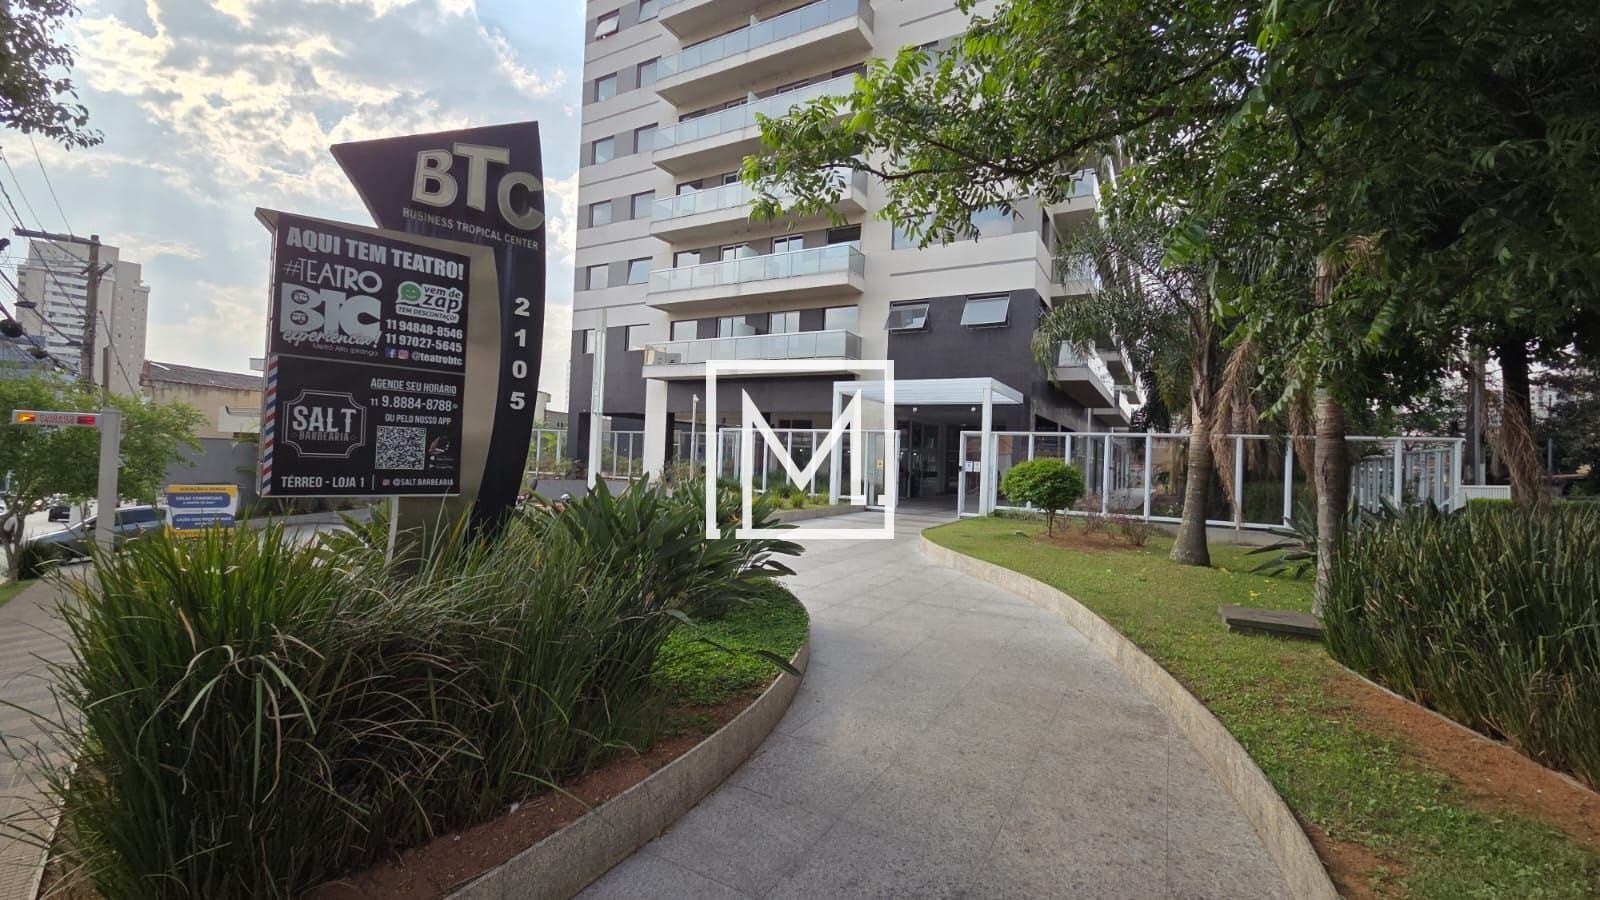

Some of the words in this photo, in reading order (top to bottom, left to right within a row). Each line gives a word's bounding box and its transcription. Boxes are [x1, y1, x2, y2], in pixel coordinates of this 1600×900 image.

[411, 142, 545, 231] BTC
[402, 207, 454, 229] BUSINESS
[456, 221, 502, 241] TROPICAL
[504, 234, 539, 250] CENTER
[286, 226, 340, 255] AQUI
[345, 238, 386, 265] TEM
[392, 249, 464, 281] TEATRO!
[283, 257, 383, 294] #TEATRO
[424, 286, 446, 297] vem
[448, 290, 461, 299] de
[280, 282, 382, 338] BTC
[422, 294, 460, 313] zap
[386, 319, 397, 330] 11
[385, 333, 397, 344] 11
[399, 335, 462, 352] 97027-5645
[411, 350, 463, 366] @teatrobtc
[510, 297, 530, 410] 2105
[370, 378, 405, 390] AGENDE
[406, 381, 422, 392] SEU
[371, 398, 379, 407] 11
[382, 395, 452, 412] 9.8884-8788
[292, 405, 357, 433] SALT
[385, 413, 395, 422] OU
[396, 413, 414, 423] PELO
[414, 415, 437, 425] NOSSO
[438, 417, 452, 425] APP
[298, 431, 349, 441] BARBEARIA
[281, 474, 323, 488] TÉRREO
[332, 476, 356, 488] LOJA
[360, 476, 365, 488] 1
